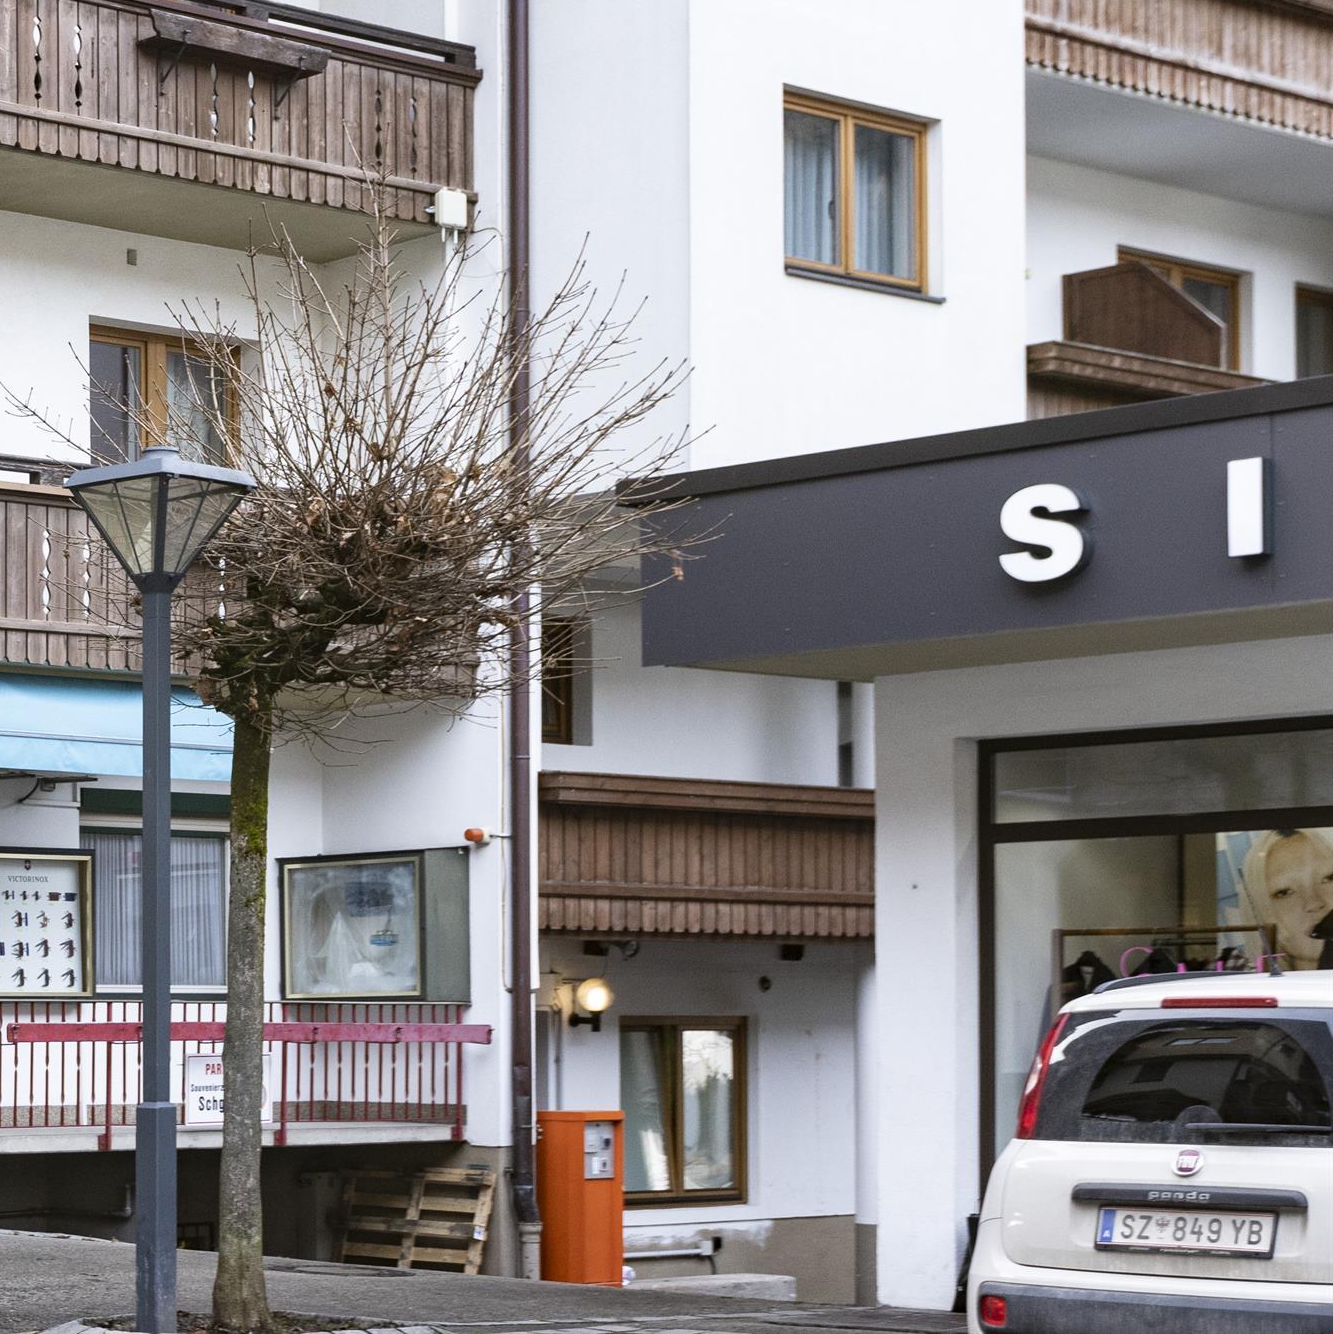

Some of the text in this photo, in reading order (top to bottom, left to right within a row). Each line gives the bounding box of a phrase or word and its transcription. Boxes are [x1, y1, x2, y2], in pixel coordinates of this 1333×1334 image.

[7, 875, 49, 883] VICTORINOX
[205, 1063, 224, 1075] PAR
[1148, 1190, 1211, 1201] panda
